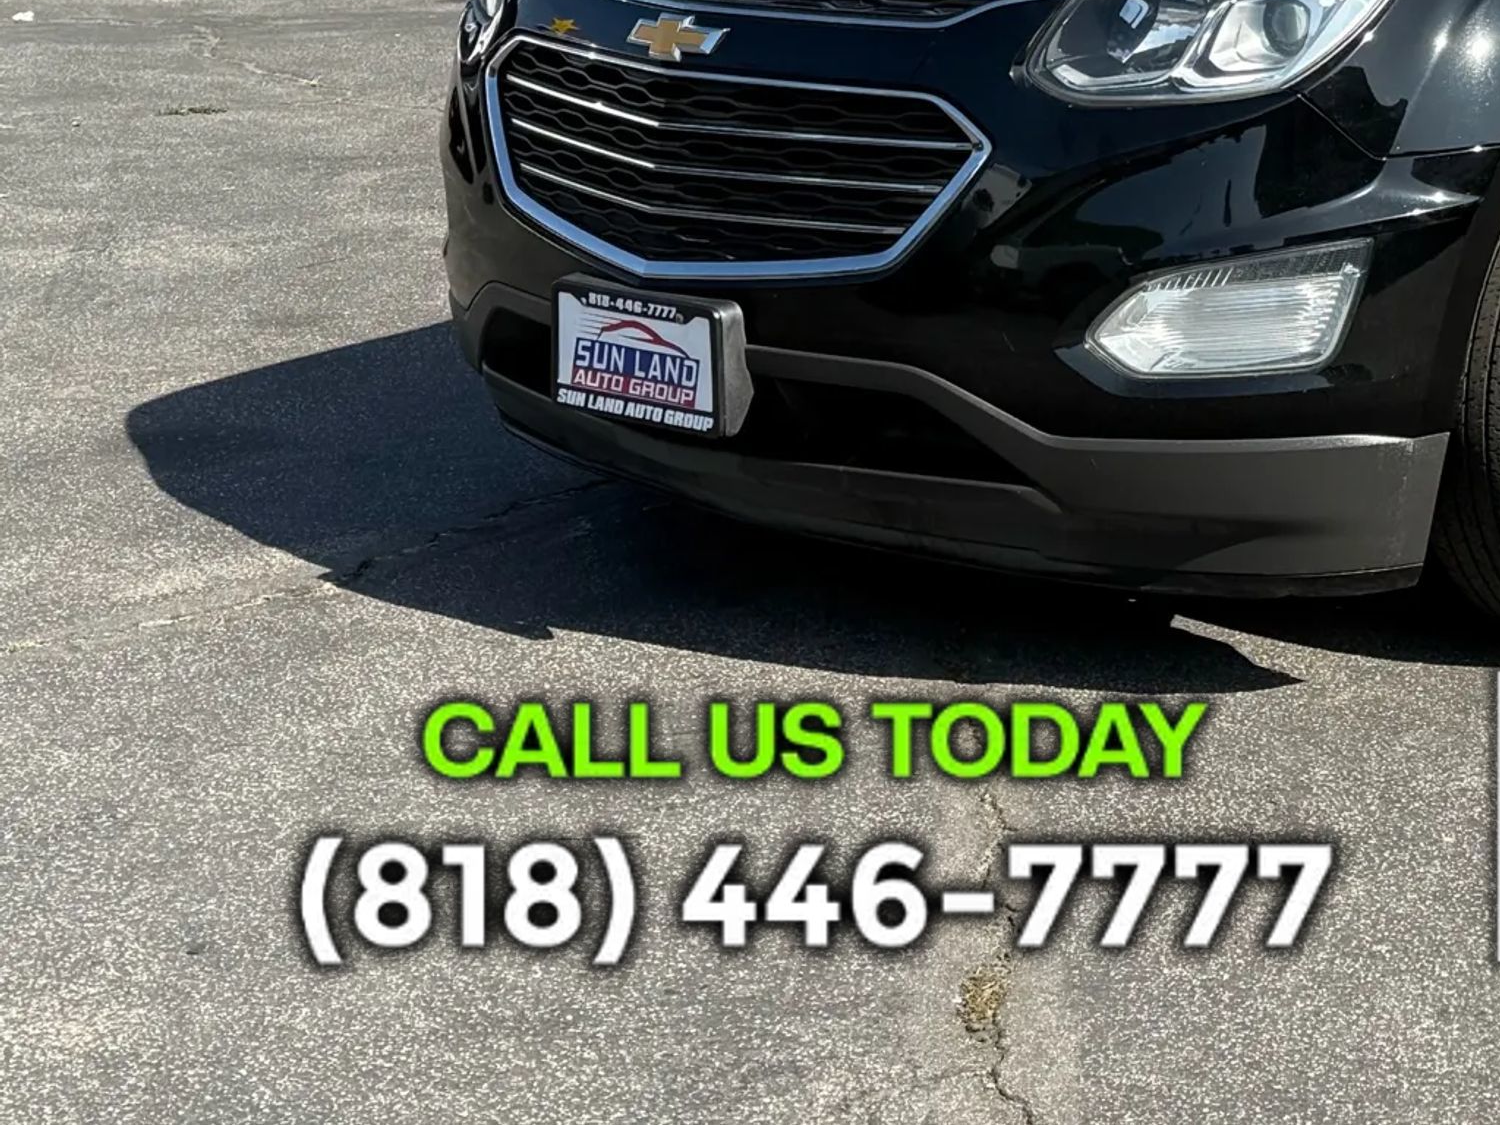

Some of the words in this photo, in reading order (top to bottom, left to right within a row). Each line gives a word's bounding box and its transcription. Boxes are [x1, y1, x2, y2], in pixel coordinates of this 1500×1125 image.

[588, 293, 677, 319] 818-446-7777
[575, 340, 625, 374] SUN
[634, 350, 698, 388] LAND
[574, 369, 623, 392] AUTO
[628, 379, 694, 405] GROUP
[557, 388, 587, 408] SUN
[587, 394, 623, 415] LAND
[624, 402, 664, 423] AUTO
[664, 410, 714, 432] GROUP
